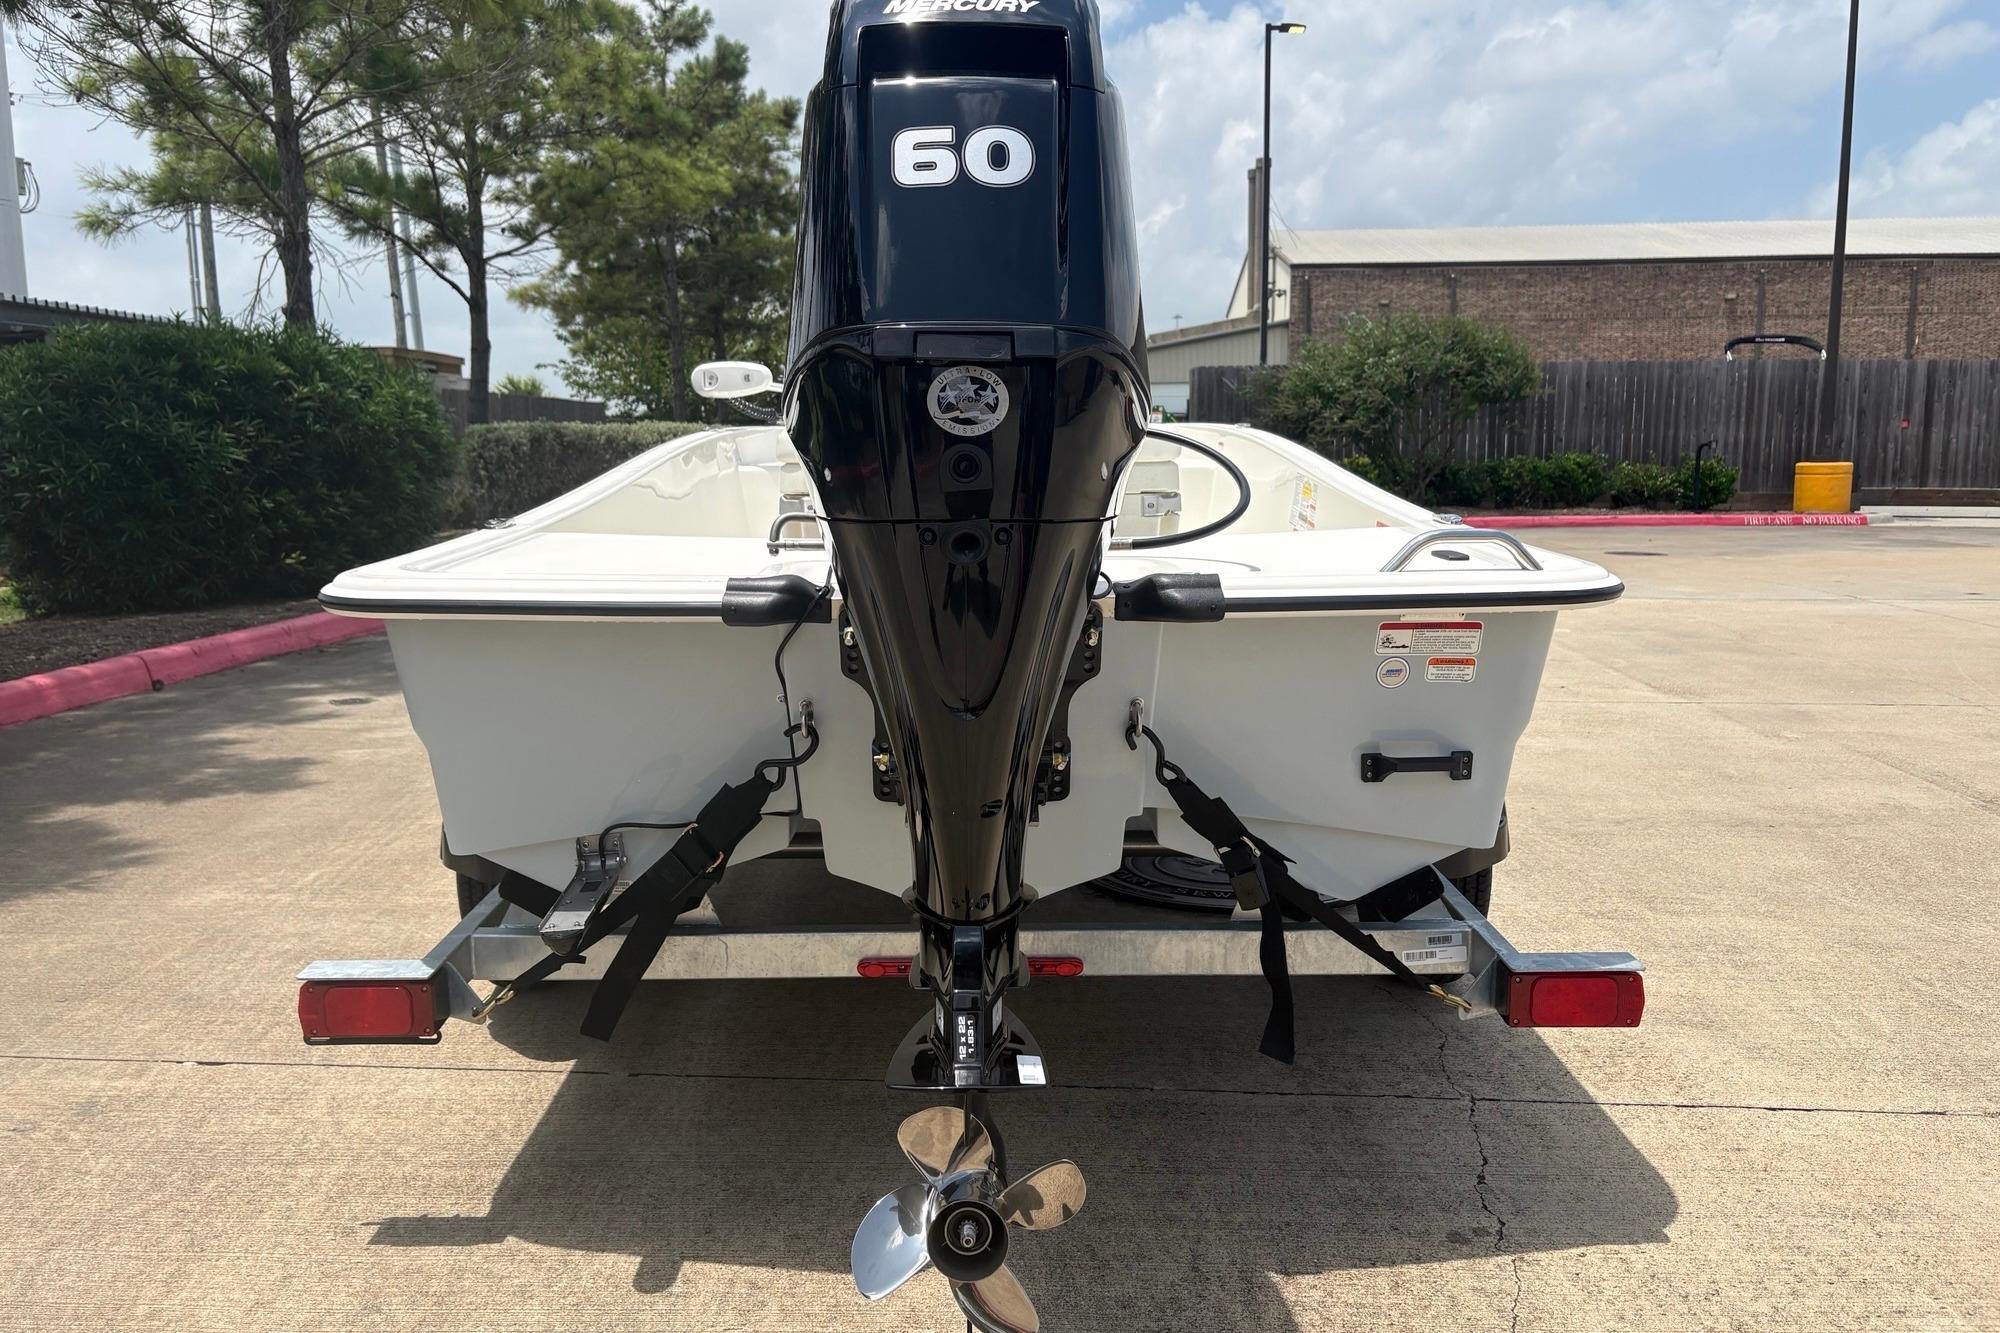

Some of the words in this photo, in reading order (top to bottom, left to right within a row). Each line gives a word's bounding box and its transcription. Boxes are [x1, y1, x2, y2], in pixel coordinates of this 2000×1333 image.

[883, 0, 1040, 13] MERCURY
[891, 125, 1036, 188] 60
[979, 369, 1002, 387] LOW
[1744, 516, 1765, 525] FIRE
[1767, 516, 1792, 525] LANE
[1803, 516, 1817, 525] NO
[1820, 516, 1861, 525] PARKING
[958, 1016, 966, 1033] 22
[959, 1045, 967, 1060] 12
